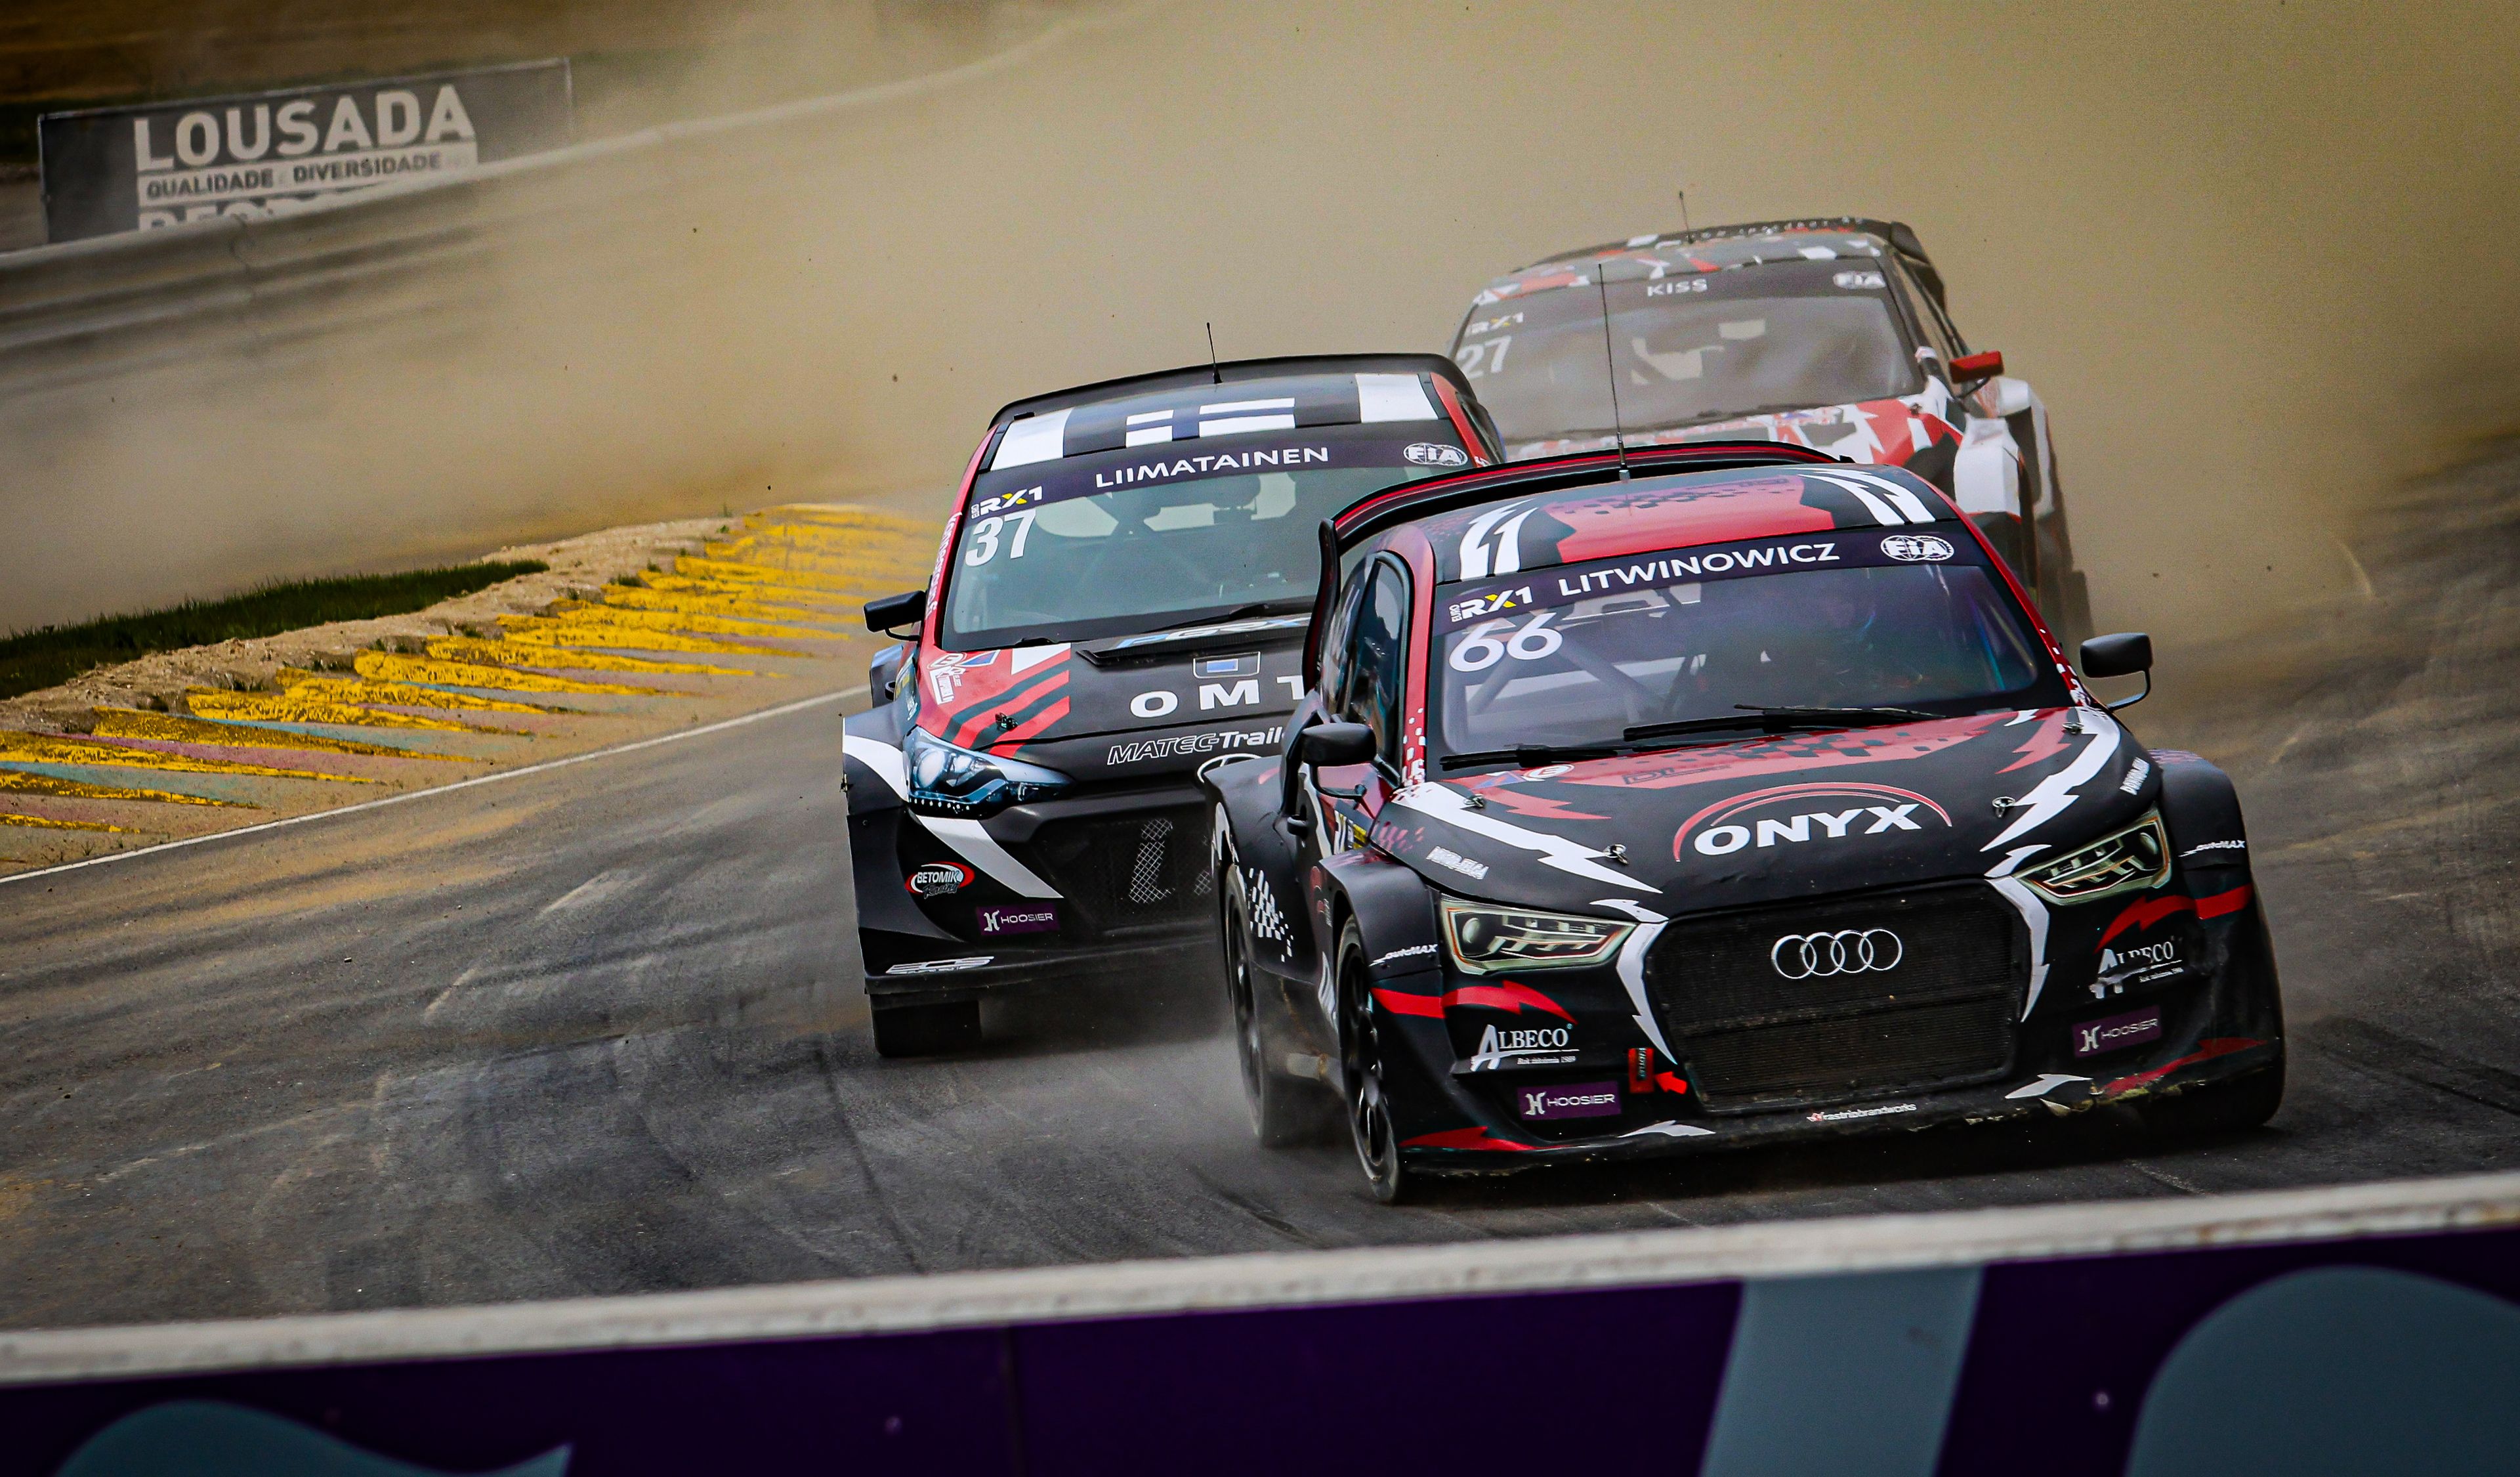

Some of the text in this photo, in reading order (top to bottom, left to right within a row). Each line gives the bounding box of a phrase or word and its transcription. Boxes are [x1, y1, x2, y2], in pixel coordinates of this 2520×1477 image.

[134, 84, 476, 173] LOUSADA
[146, 167, 274, 200] QUALIDADE
[293, 152, 441, 182] DIVERSIDADE
[1647, 278, 1708, 297] KISS
[1456, 335, 1512, 379] 27
[1096, 446, 1330, 488] LIIMATAINEN
[980, 485, 1043, 516] RX1
[965, 508, 1036, 567] 37
[1558, 542, 1840, 597] LITWINOWICZ
[1449, 586, 1533, 622] EURO RX1
[1448, 612, 1563, 672] 66
[1106, 725, 1283, 765] MATEC-Trail
[1694, 803, 1922, 855] ONYX
[917, 870, 959, 884] BETOMIK
[1000, 912, 1053, 924] HOOSIER
[1471, 1024, 1569, 1072] ALBECO
[2101, 1018, 2158, 1040] HOOSIER
[1547, 1094, 1616, 1107] HOOSIER
